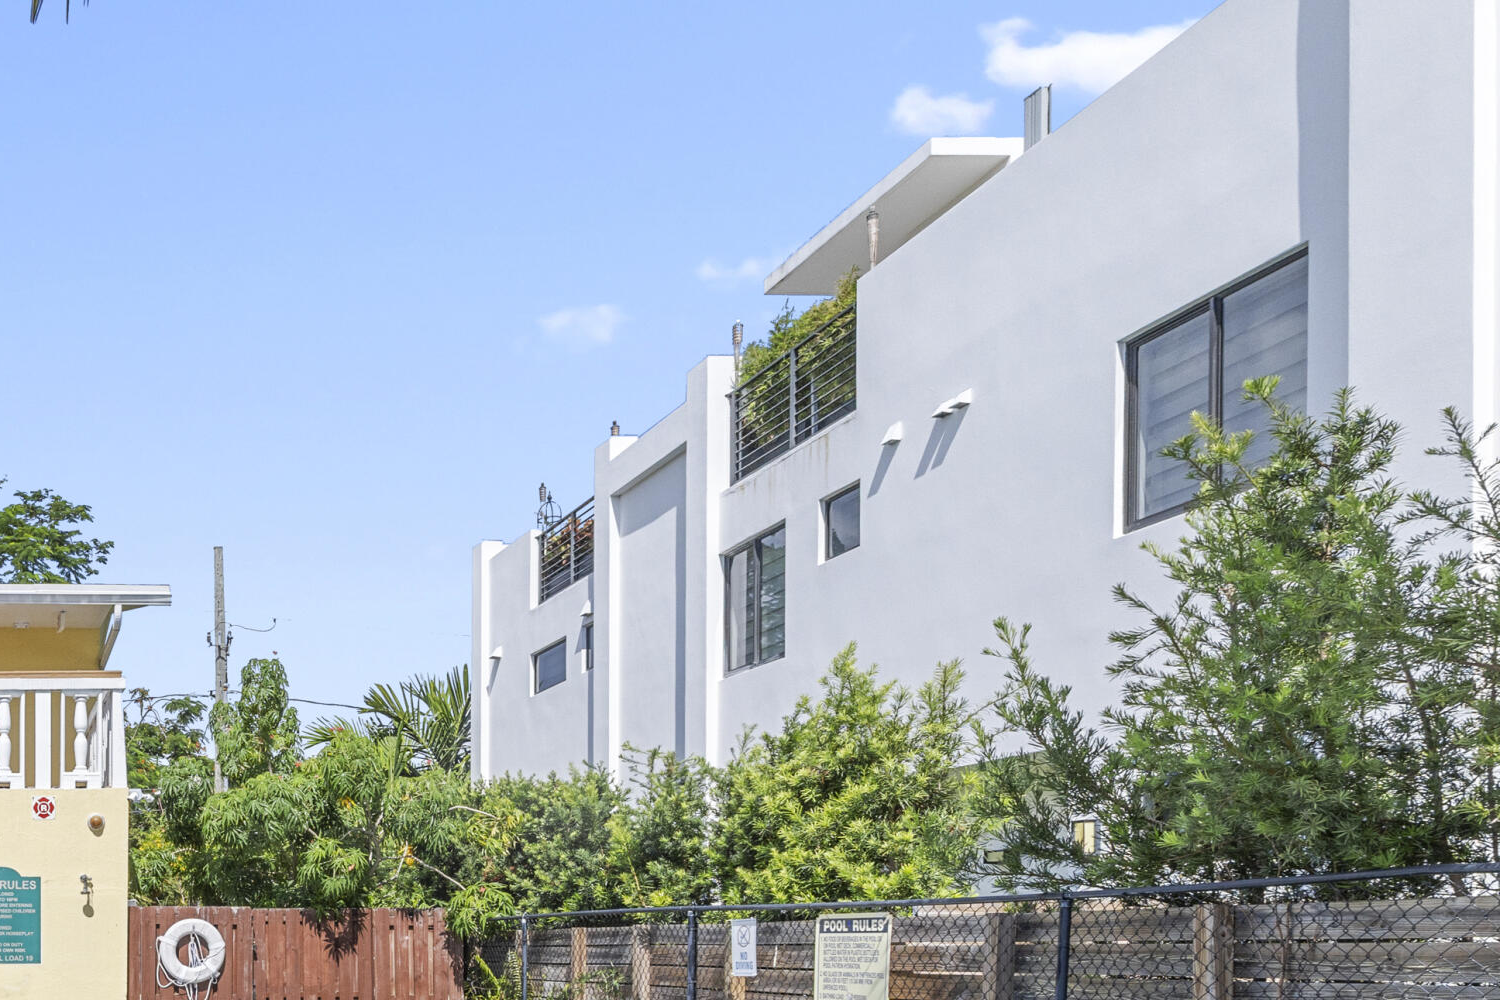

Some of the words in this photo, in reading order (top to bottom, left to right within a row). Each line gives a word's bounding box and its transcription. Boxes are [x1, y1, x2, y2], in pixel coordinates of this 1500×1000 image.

[0, 880, 36, 890] RULES
[823, 920, 848, 932] POOL
[852, 919, 884, 932] RULES
[736, 961, 753, 969] DIVING
